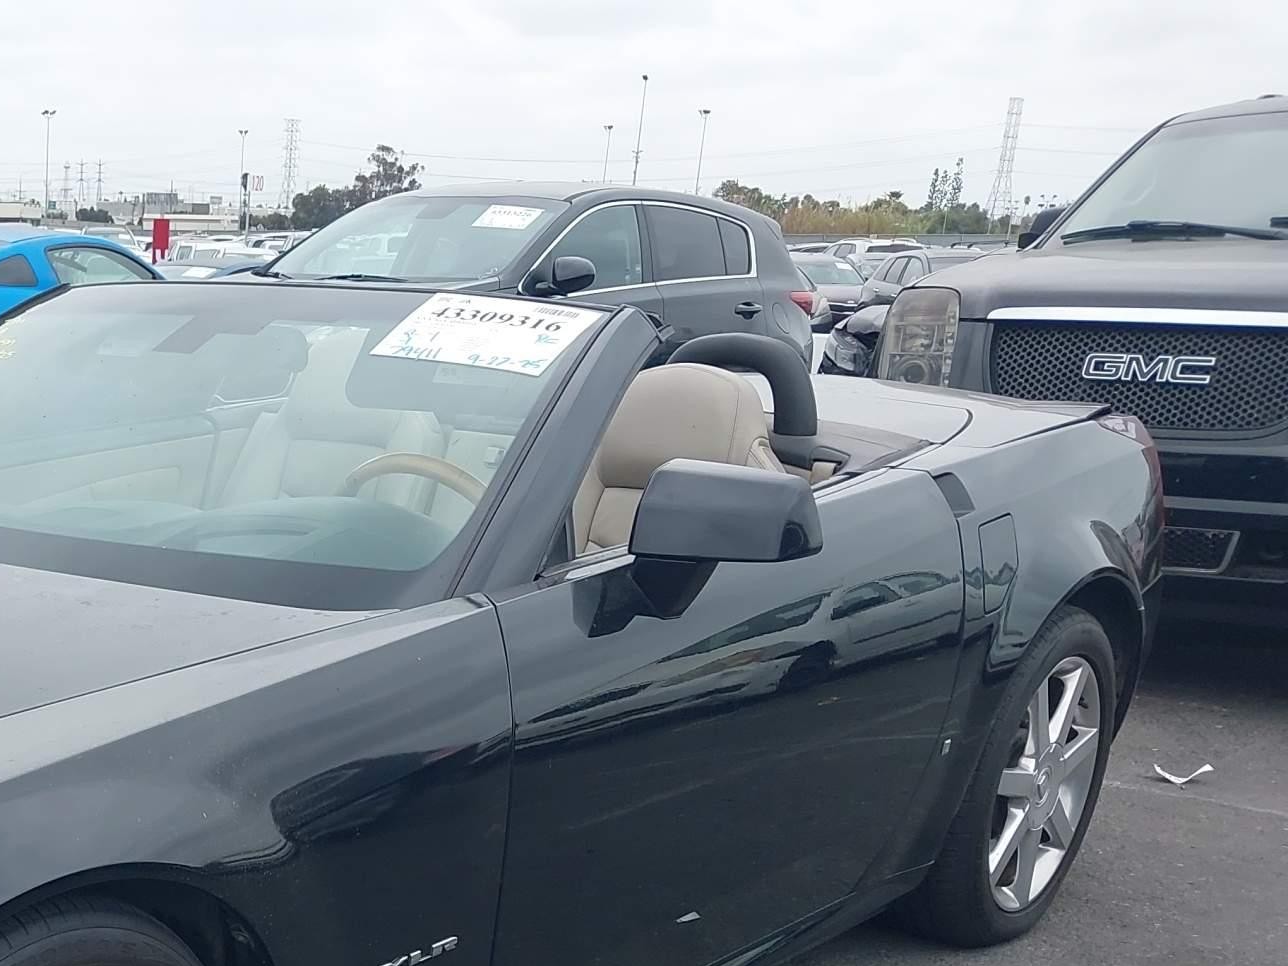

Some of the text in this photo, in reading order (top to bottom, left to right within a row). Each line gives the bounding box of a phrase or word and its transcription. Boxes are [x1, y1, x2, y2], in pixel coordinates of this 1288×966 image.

[253, 175, 264, 191] 120
[432, 306, 564, 333] 43309316
[1082, 353, 1216, 384] GMC
